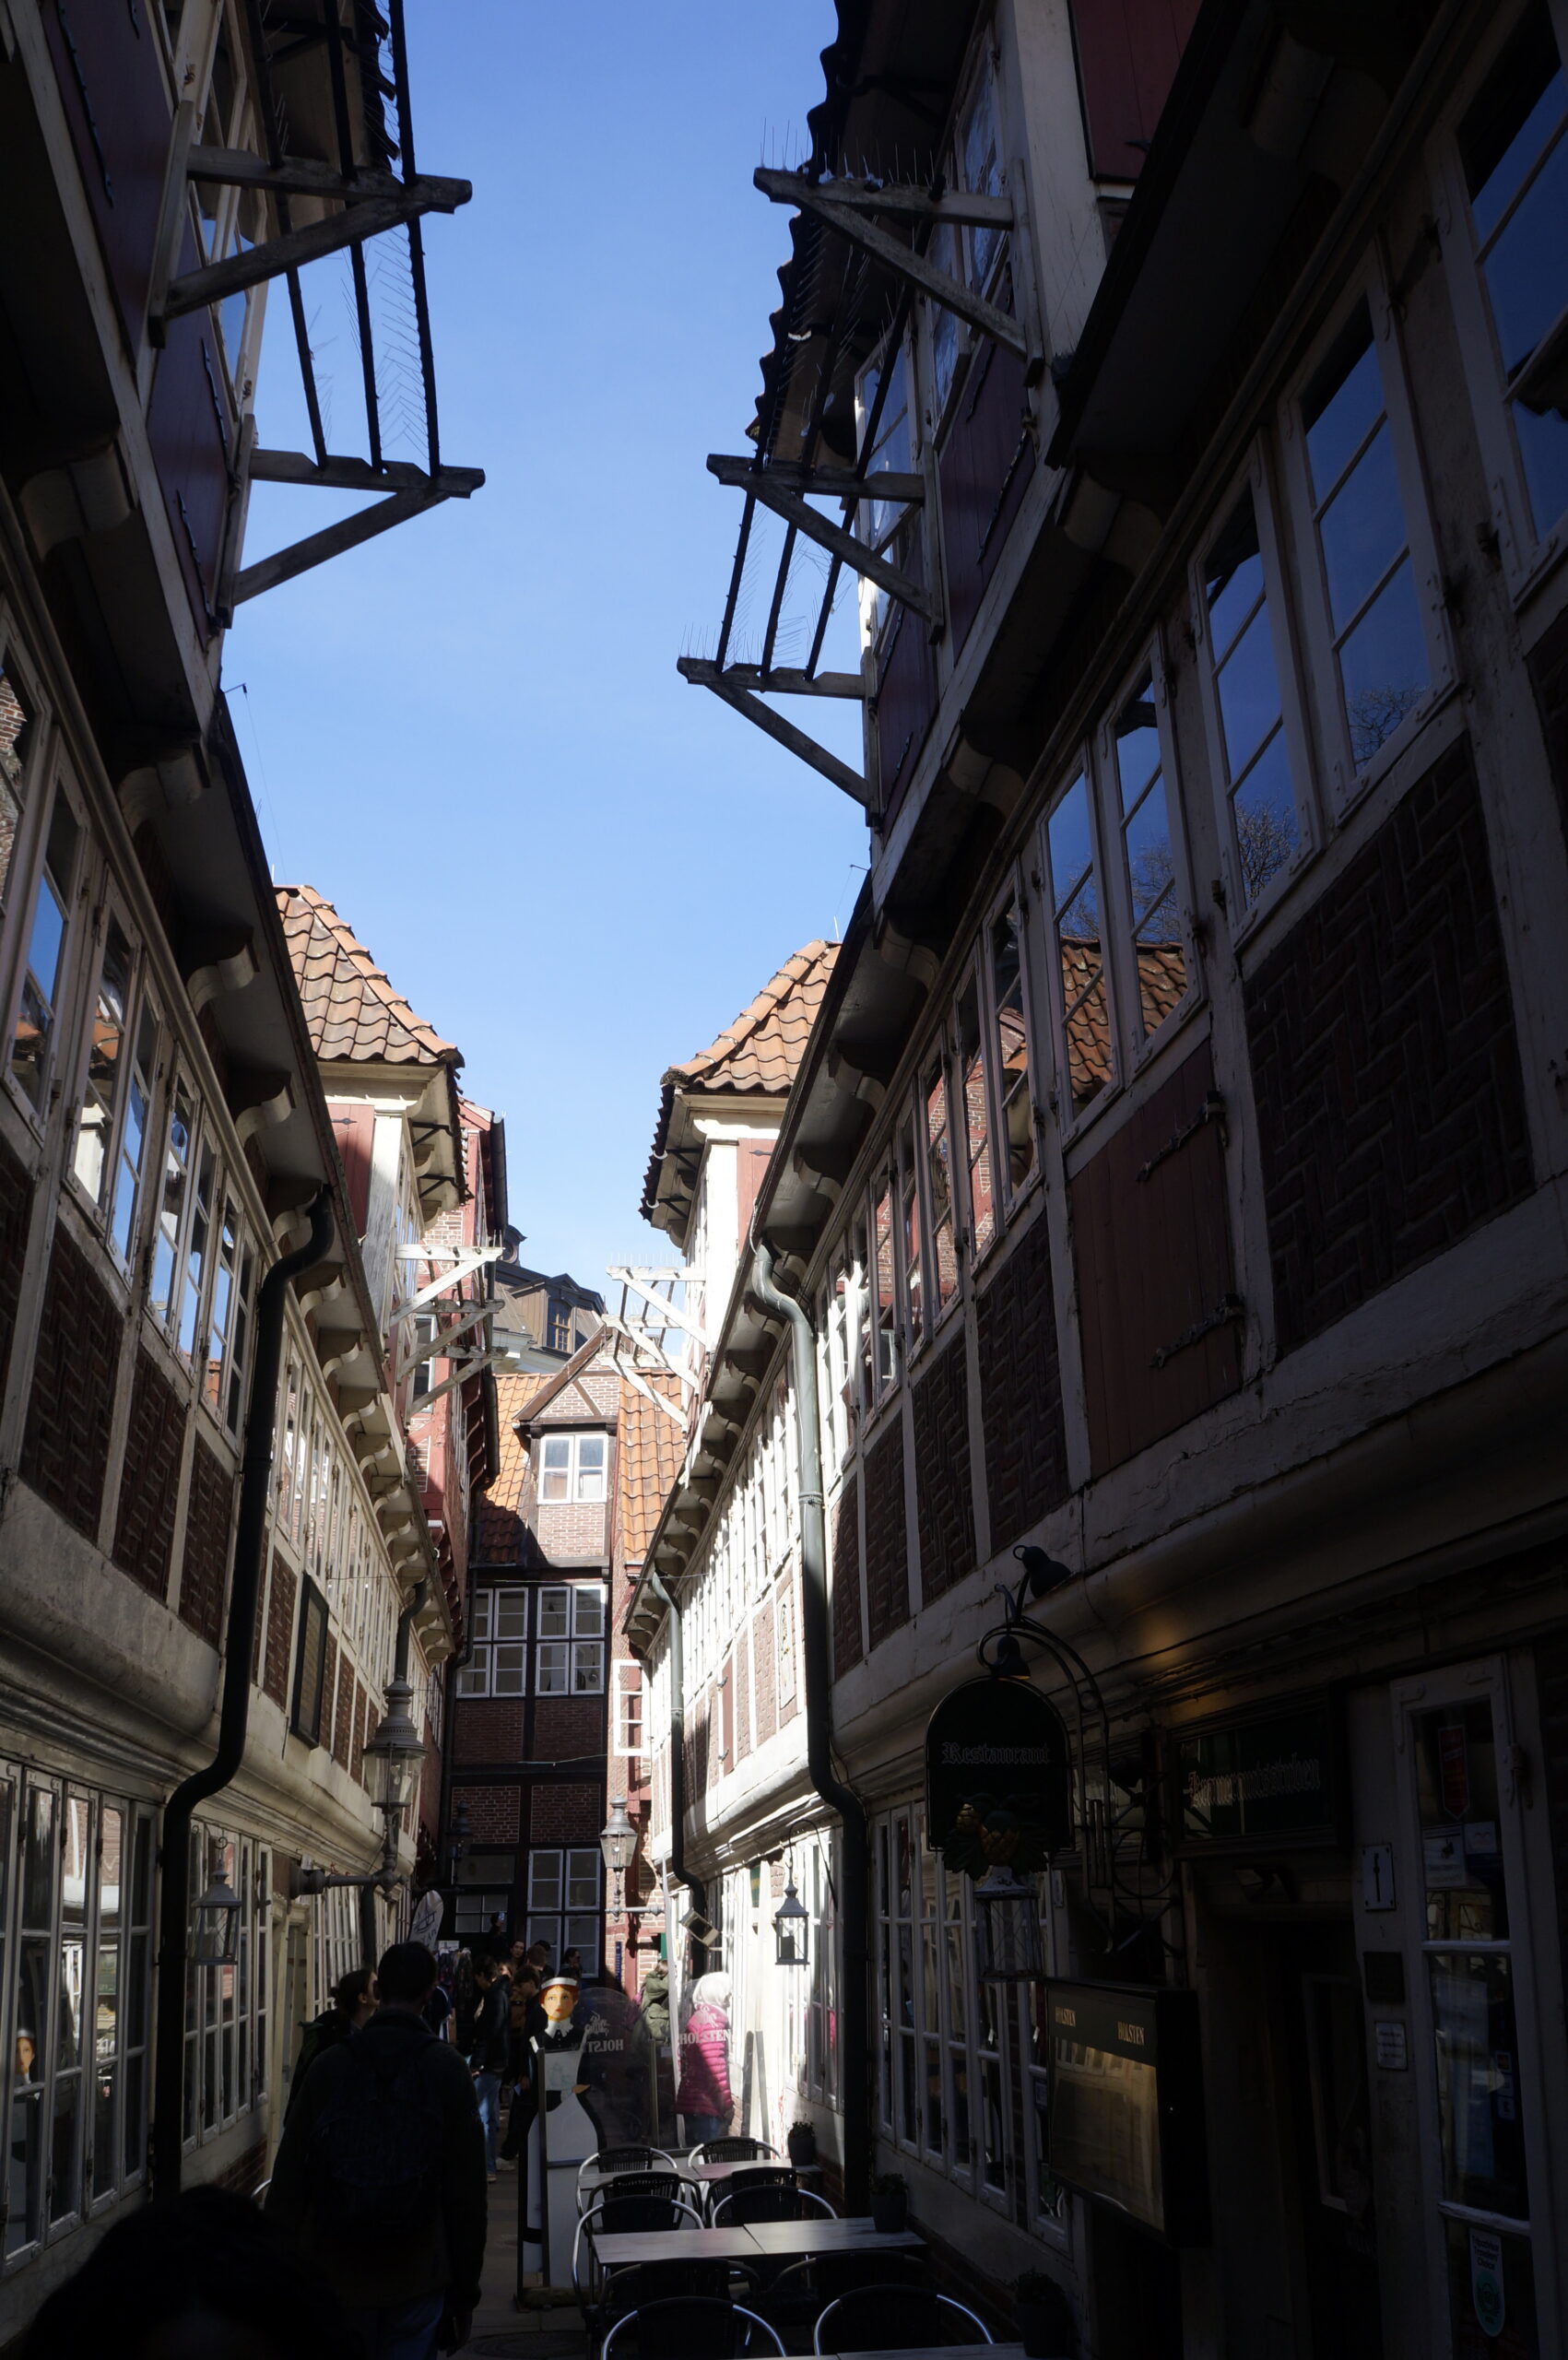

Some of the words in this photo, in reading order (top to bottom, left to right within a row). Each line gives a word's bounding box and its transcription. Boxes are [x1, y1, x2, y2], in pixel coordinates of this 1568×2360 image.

[940, 1740, 1052, 1765] Restaurant
[678, 2028, 733, 2045] HOLSTEN
[1117, 2020, 1145, 2047] HOLSTEN
